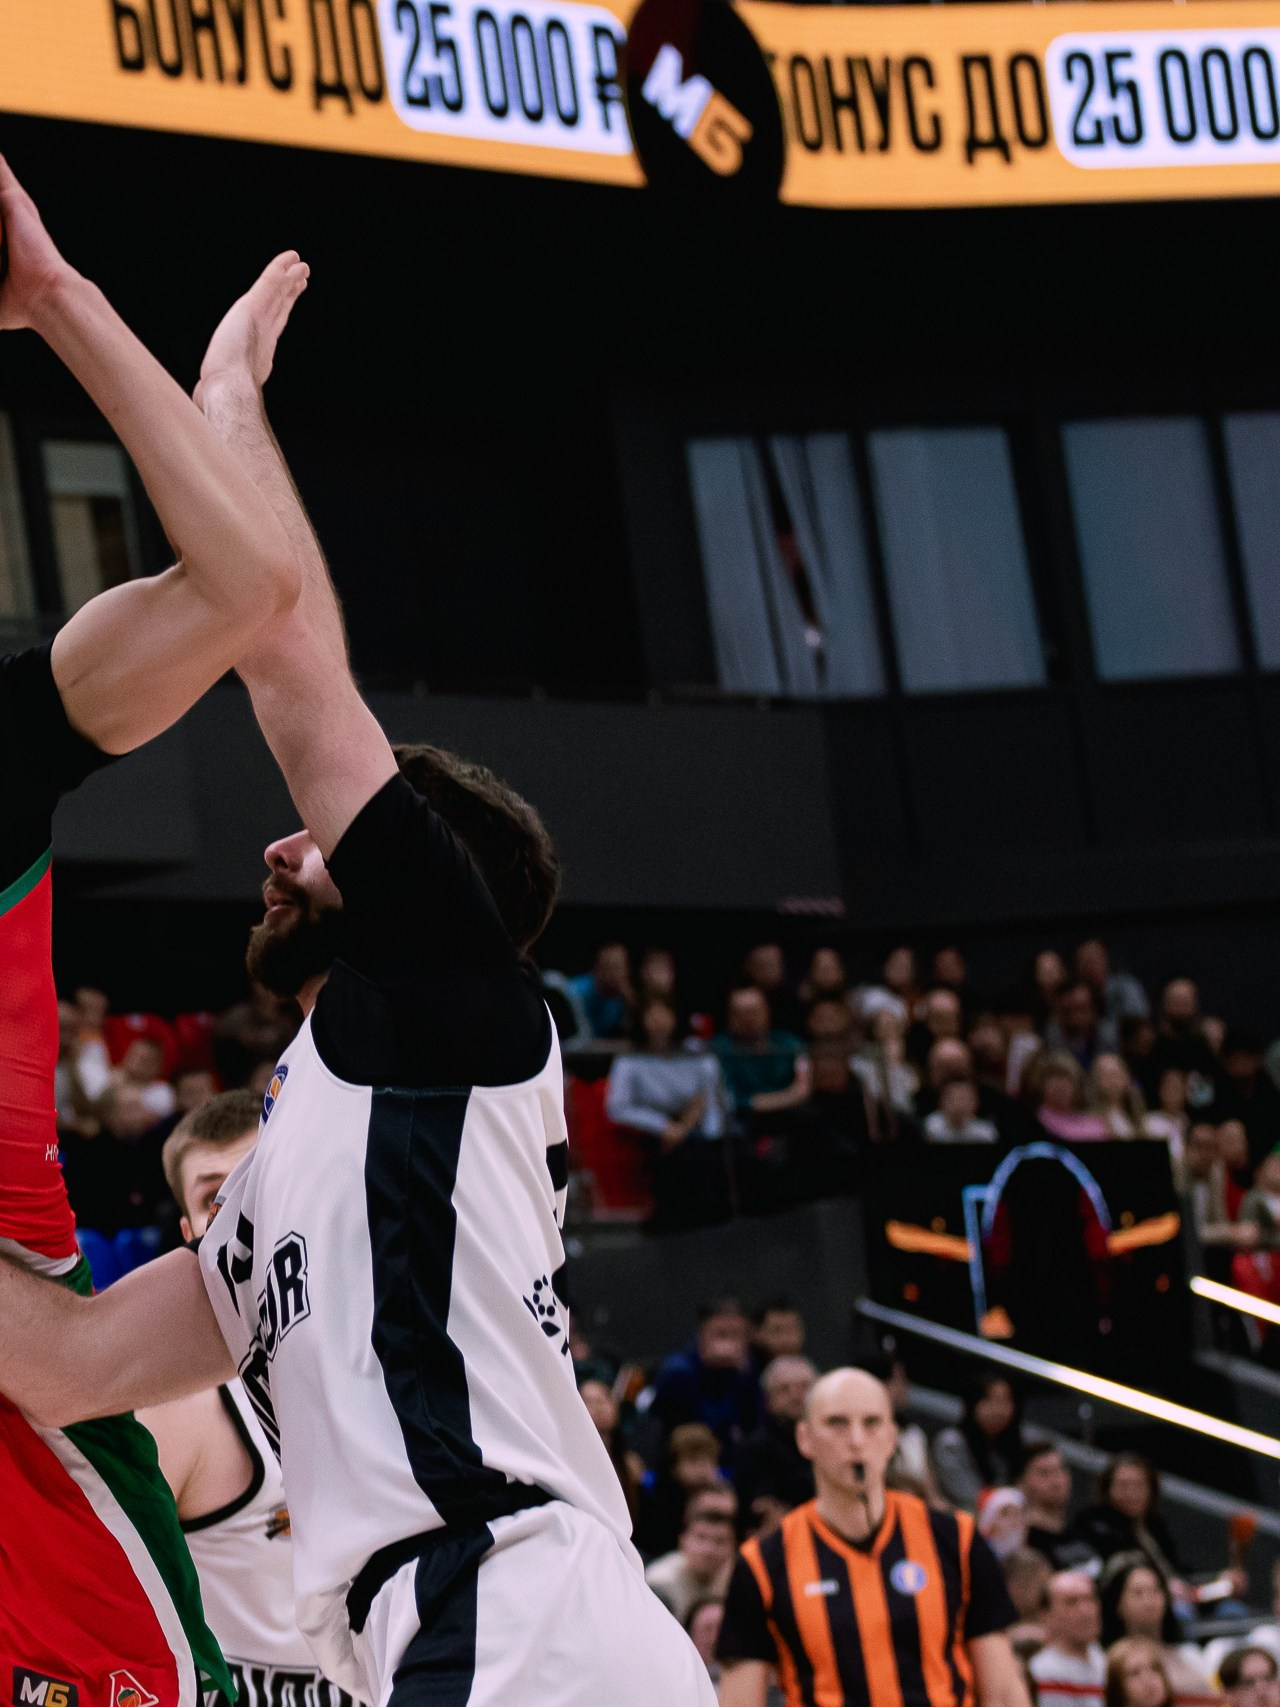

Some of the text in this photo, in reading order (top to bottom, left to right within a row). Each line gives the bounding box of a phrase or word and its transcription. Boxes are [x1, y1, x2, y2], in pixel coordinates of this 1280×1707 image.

[310, 0, 386, 115] ДО
[394, 0, 464, 112] 25
[474, 9, 580, 128] 000
[764, 46, 1280, 165] ОНУС ДО 25 000
